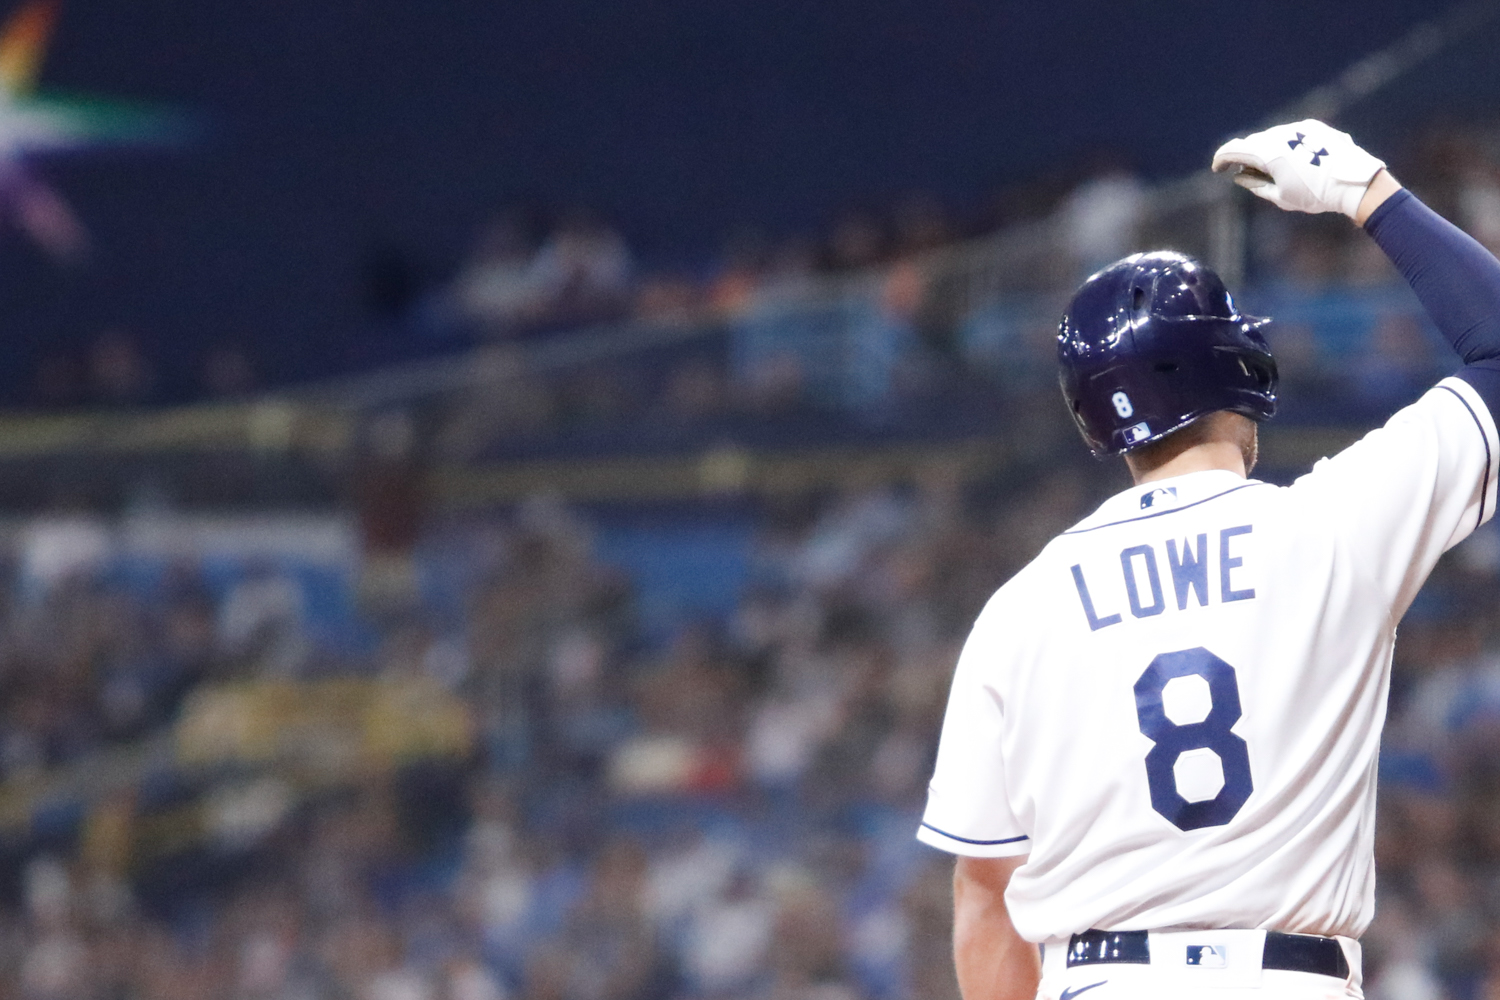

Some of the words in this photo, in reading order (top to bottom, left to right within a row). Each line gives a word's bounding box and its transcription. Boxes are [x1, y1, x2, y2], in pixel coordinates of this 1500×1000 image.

[1111, 391, 1134, 419] 8
[1070, 524, 1256, 632] LOWE
[1133, 646, 1254, 832] 8
